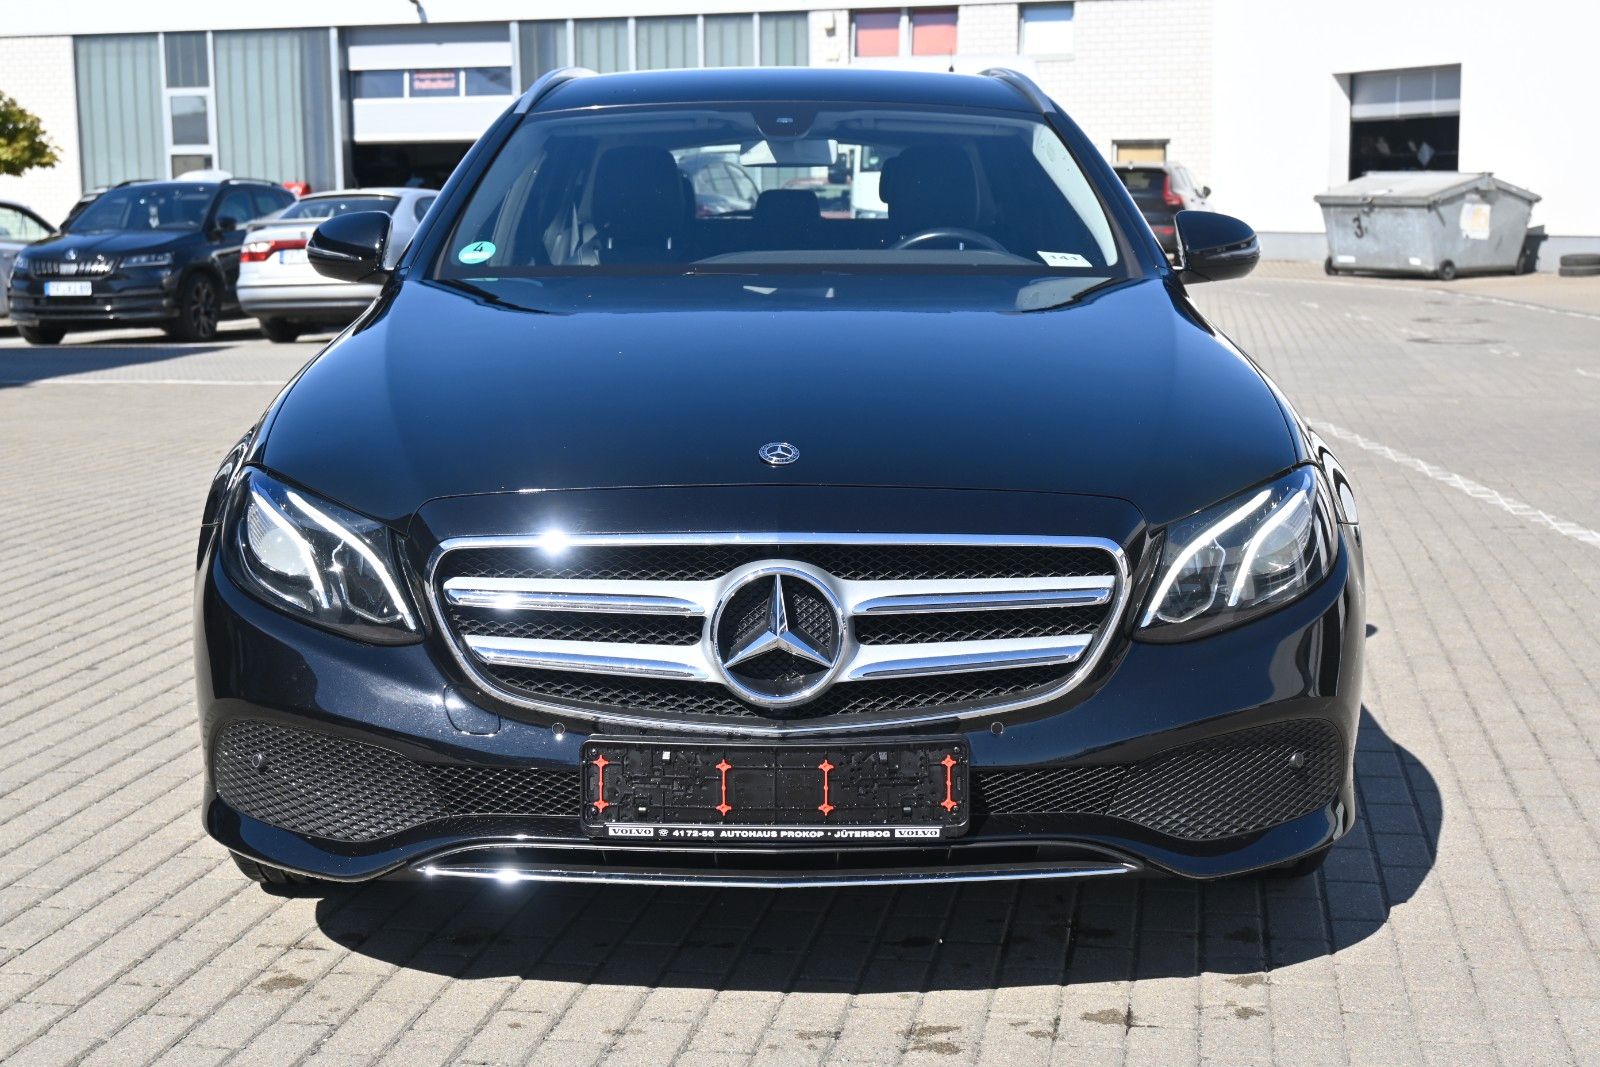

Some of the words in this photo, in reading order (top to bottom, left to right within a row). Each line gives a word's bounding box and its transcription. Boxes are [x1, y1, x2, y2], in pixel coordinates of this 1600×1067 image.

[473, 242, 483, 252] 4
[611, 828, 652, 836] VOLVO
[719, 830, 777, 838] AUTOHAUS
[780, 830, 825, 838] PROKOP
[834, 829, 891, 838] JÜTERBOG
[897, 829, 938, 837] VOLVO
